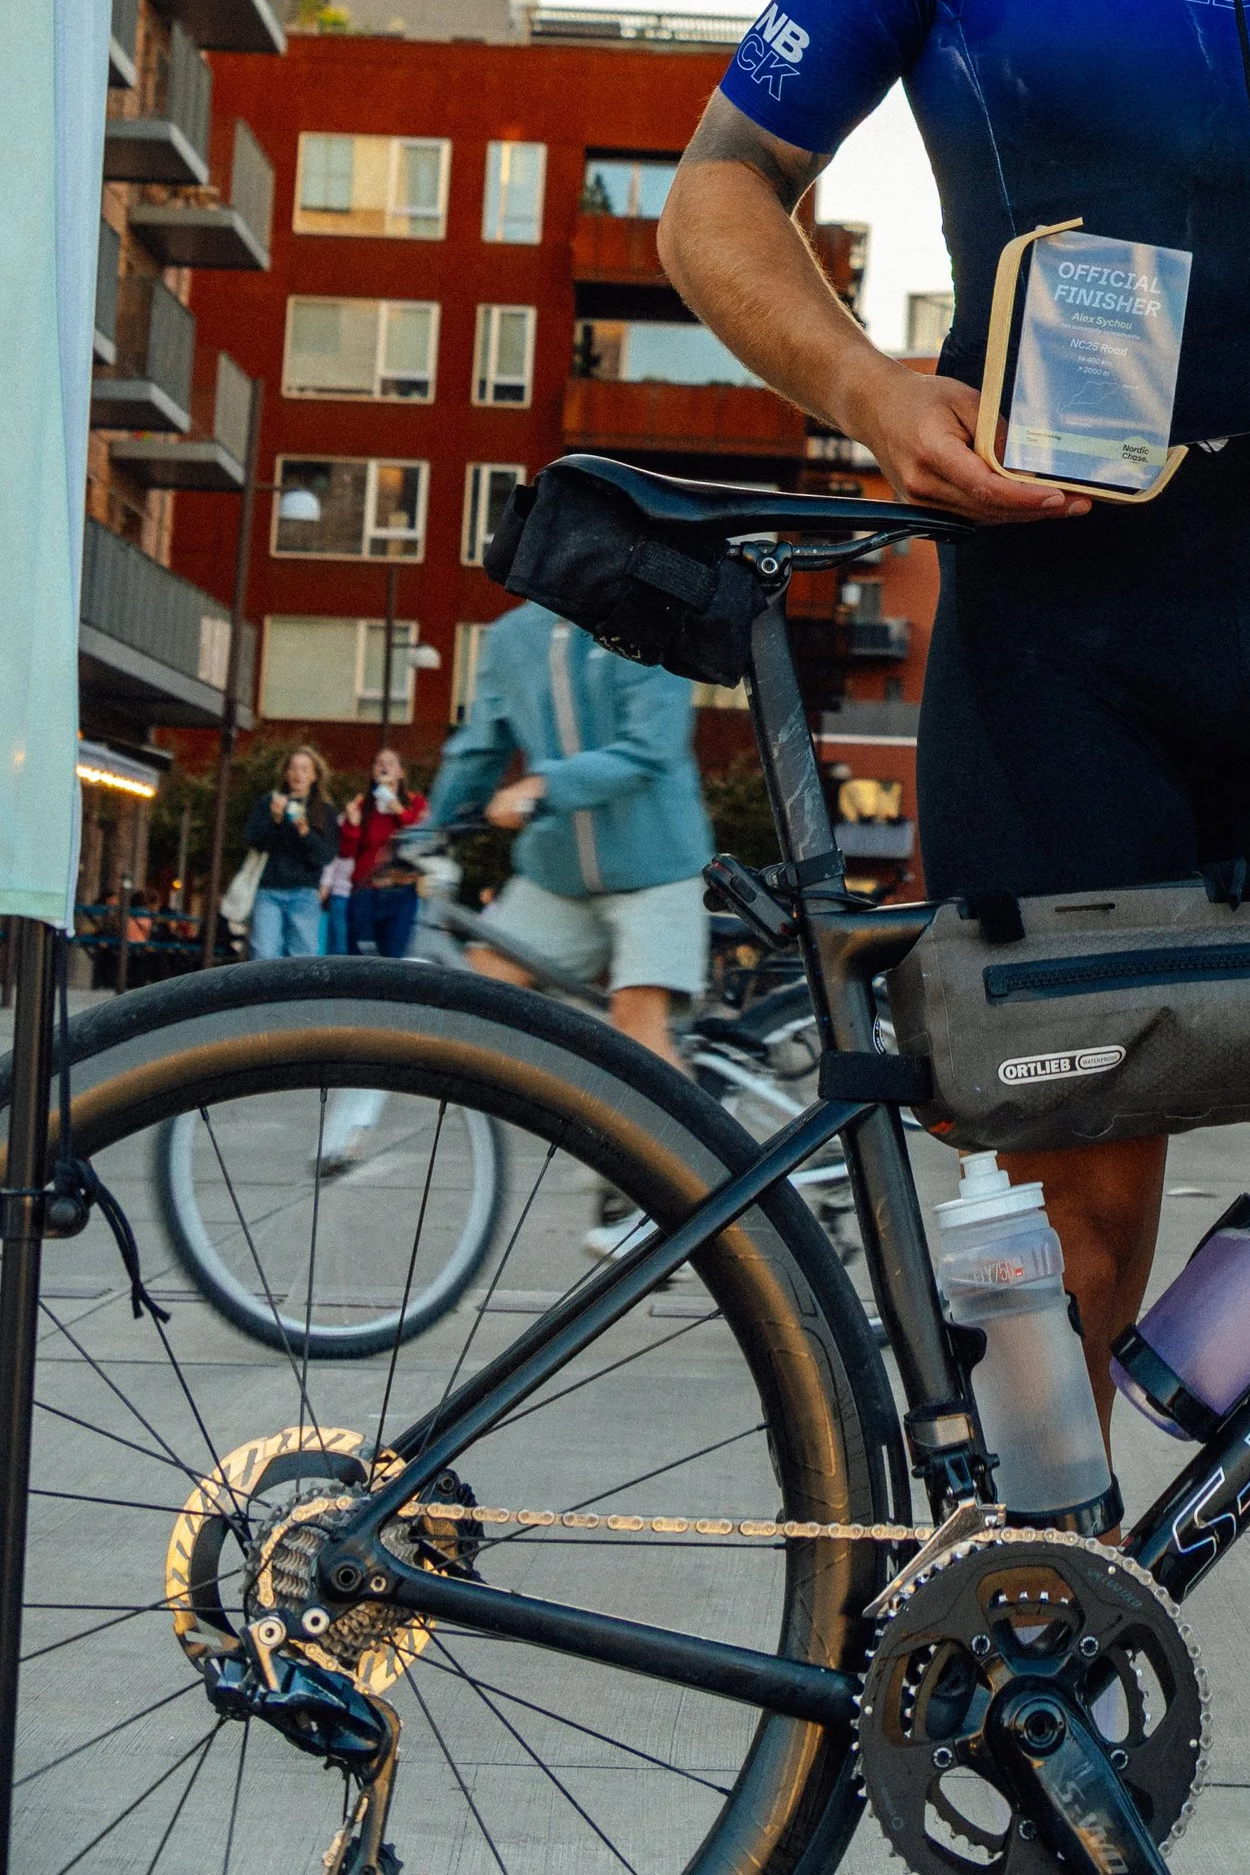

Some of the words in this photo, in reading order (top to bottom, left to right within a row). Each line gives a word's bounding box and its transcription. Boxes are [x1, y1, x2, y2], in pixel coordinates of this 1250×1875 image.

[755, 2, 810, 63] NB
[737, 33, 800, 101] CK
[1058, 261, 1161, 294] OFFICIAL
[1054, 284, 1161, 317] FINISHER
[1072, 312, 1095, 324] Alex
[1070, 338, 1100, 352] NC25
[1100, 343, 1128, 356] Road
[1122, 444, 1149, 455] Nordic
[1005, 1058, 1071, 1079] ORTLIEB
